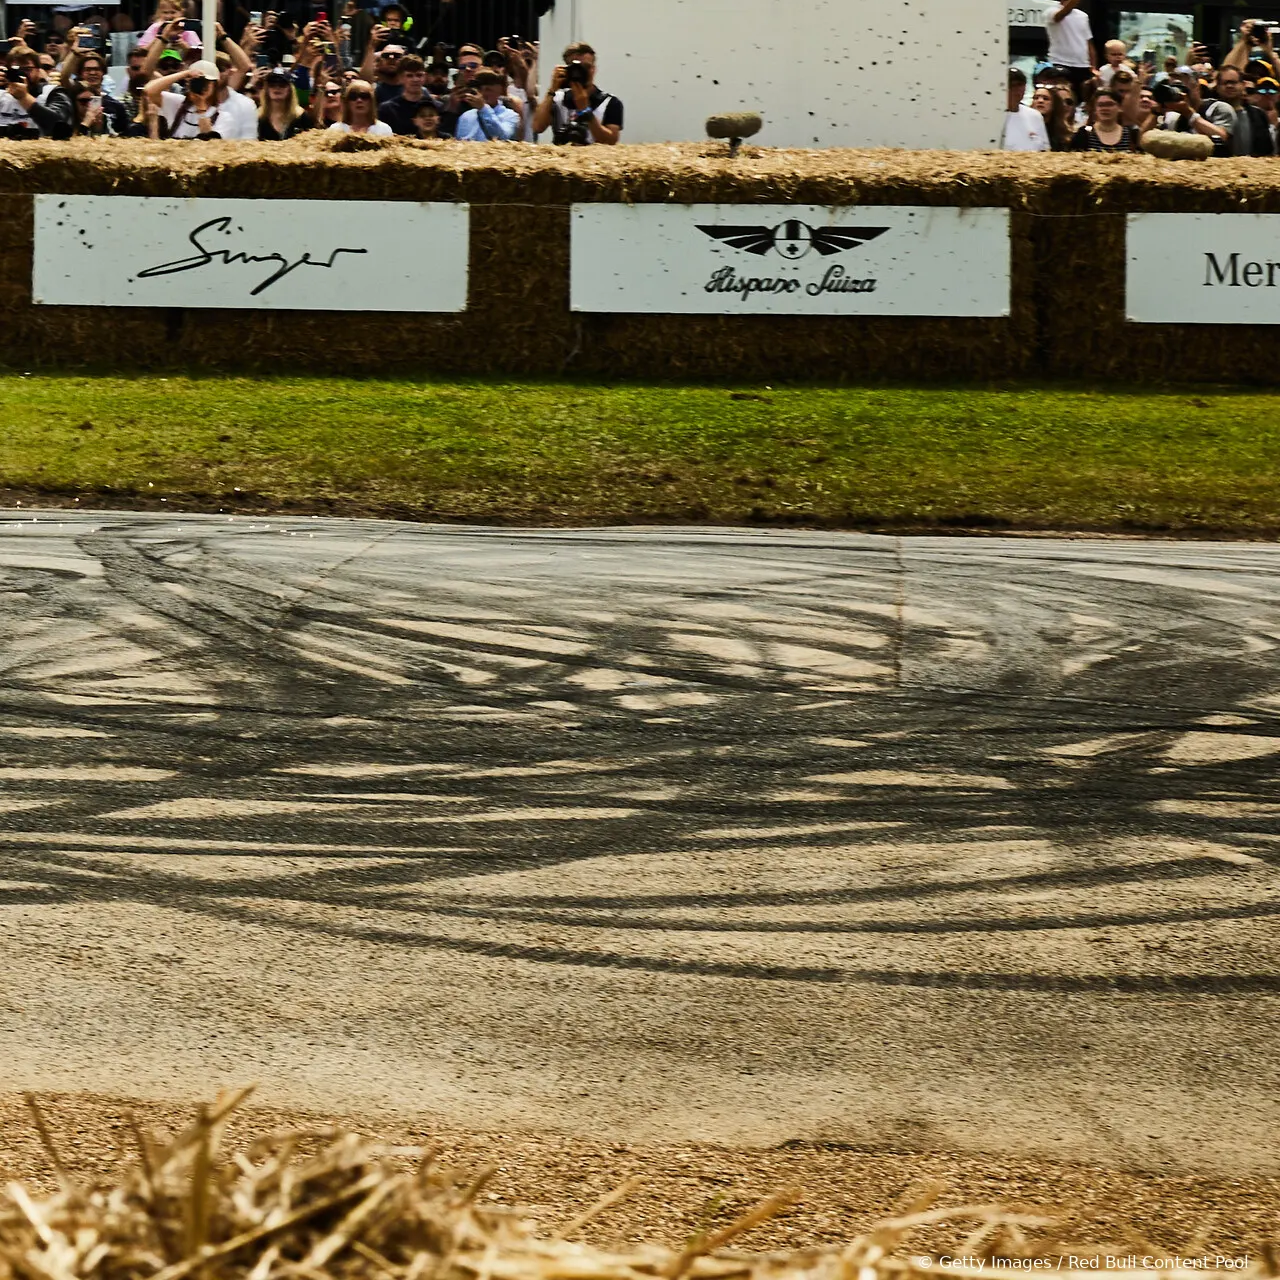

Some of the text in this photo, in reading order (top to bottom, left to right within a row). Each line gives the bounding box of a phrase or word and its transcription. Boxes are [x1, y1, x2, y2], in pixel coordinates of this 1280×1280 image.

[136, 216, 369, 296] Singer
[703, 264, 878, 302] Hispano Suiza
